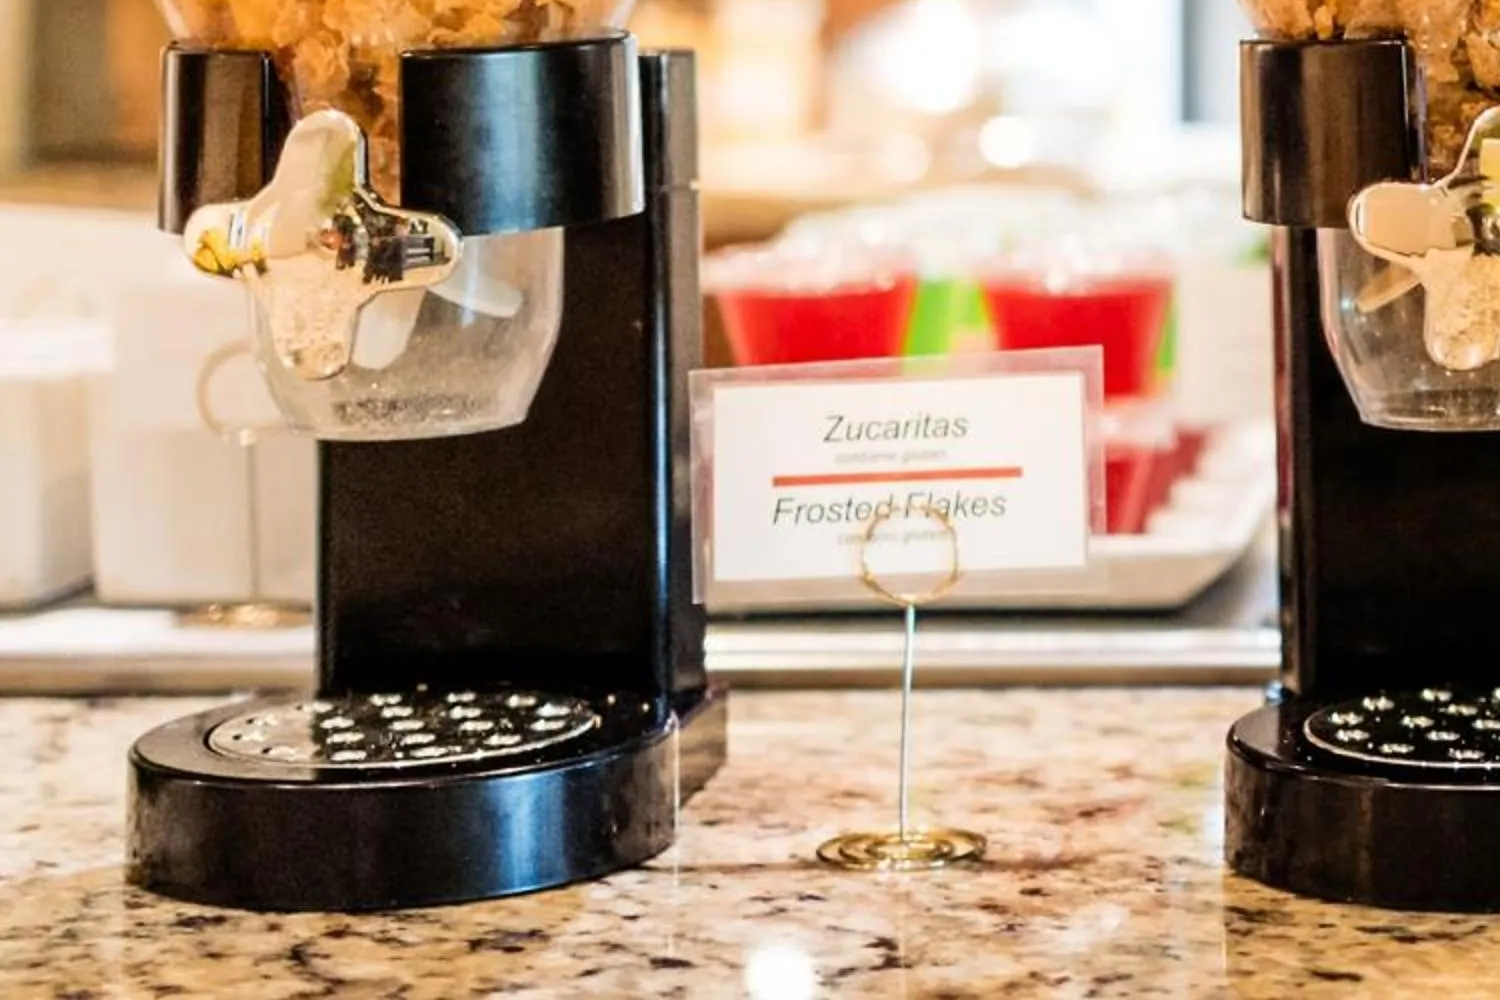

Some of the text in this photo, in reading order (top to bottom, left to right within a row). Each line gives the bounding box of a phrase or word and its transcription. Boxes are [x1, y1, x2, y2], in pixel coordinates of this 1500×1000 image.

[822, 412, 969, 444] Zucaritas
[773, 489, 1008, 526] Frosted Flakes
